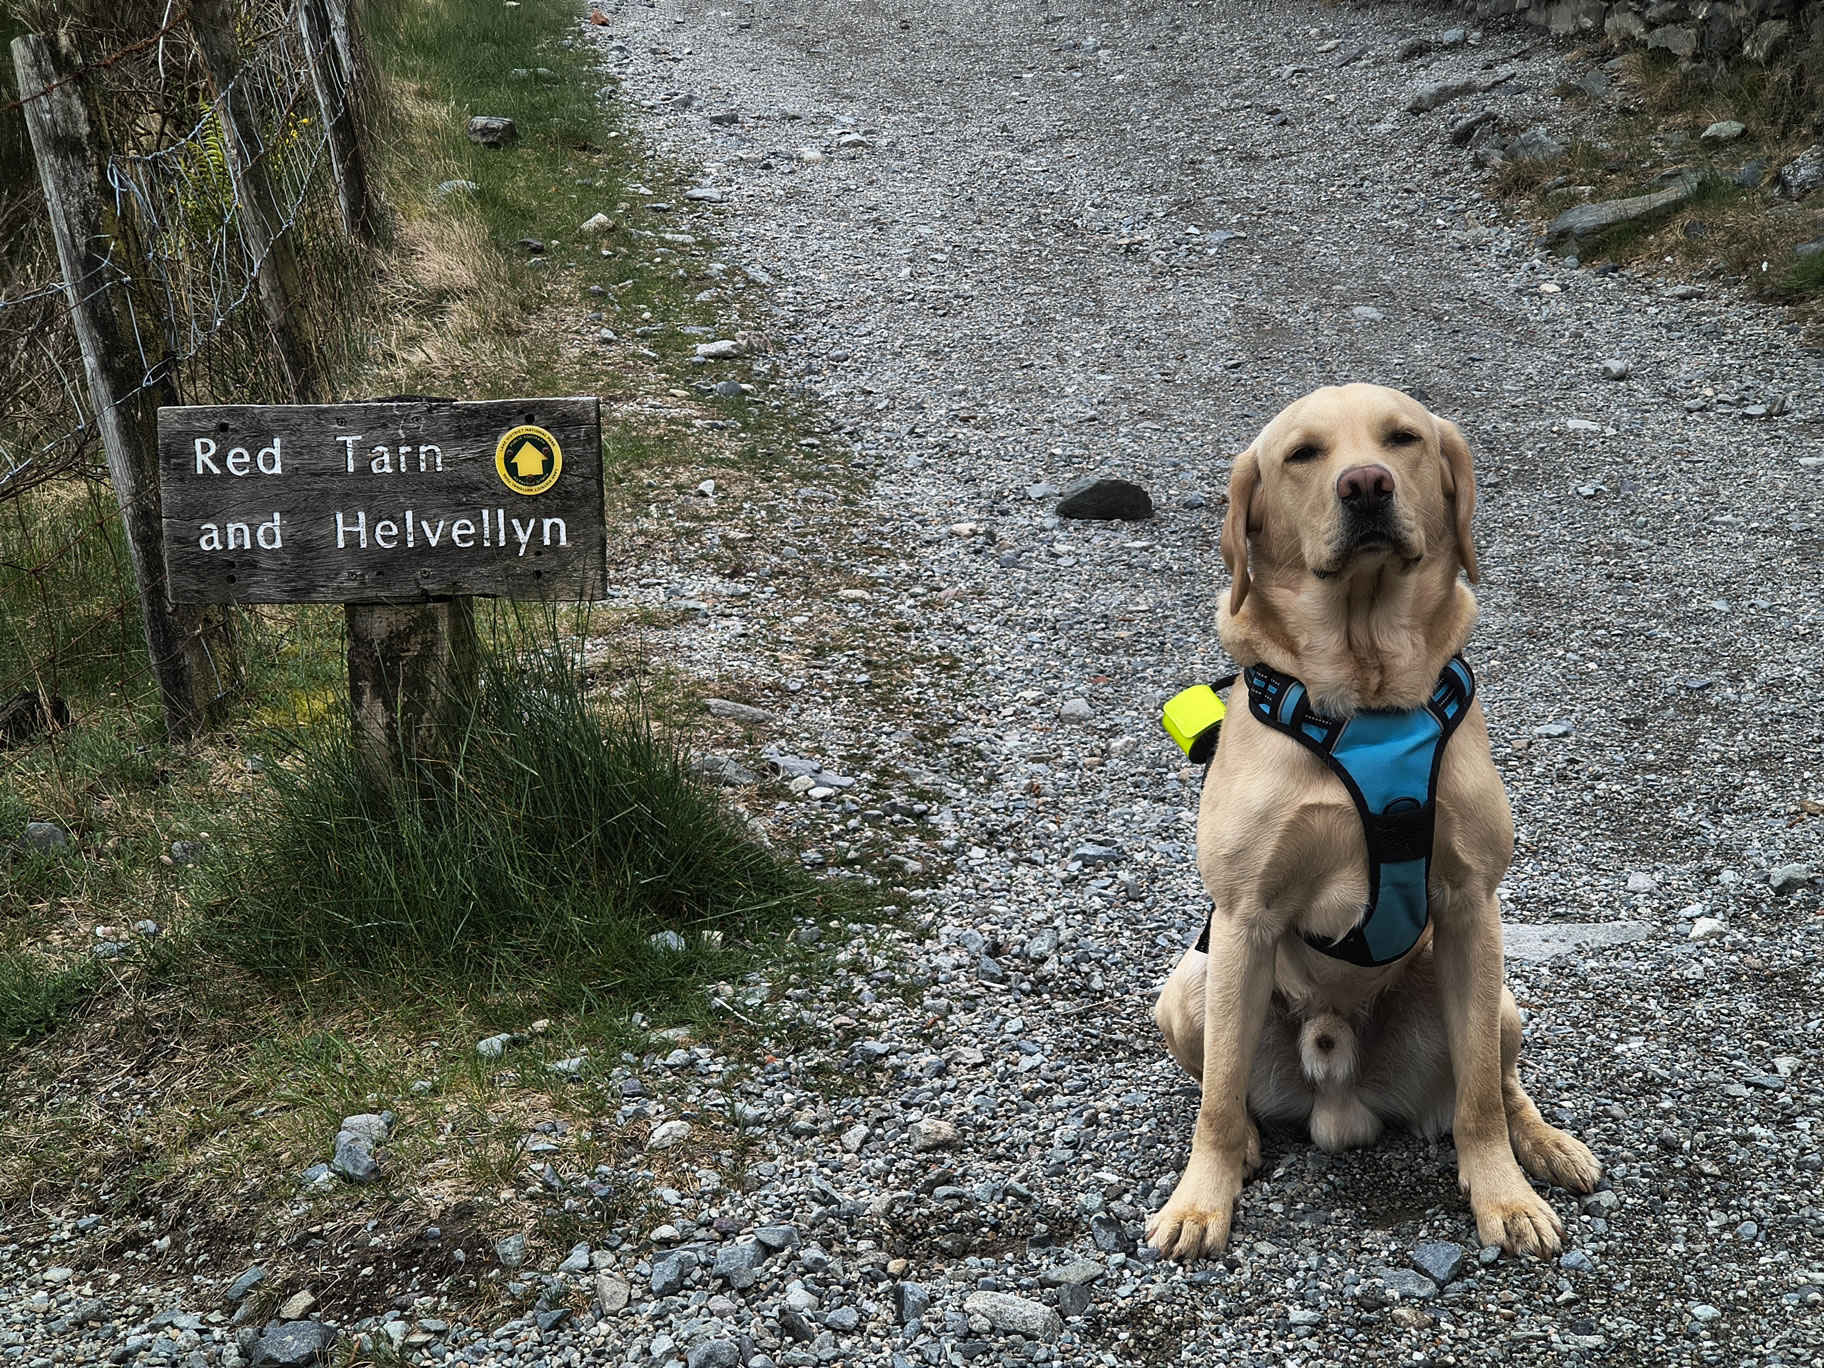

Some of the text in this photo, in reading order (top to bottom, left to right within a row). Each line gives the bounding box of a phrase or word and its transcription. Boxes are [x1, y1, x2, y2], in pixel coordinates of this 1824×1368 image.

[499, 428, 556, 452] LAKE DISTRICT NATIONAL PARK
[194, 435, 443, 476] Red Tarn
[511, 483, 534, 492] NATIONAL
[534, 479, 553, 492] DISTRICT
[199, 508, 567, 557] and Helvellyn
